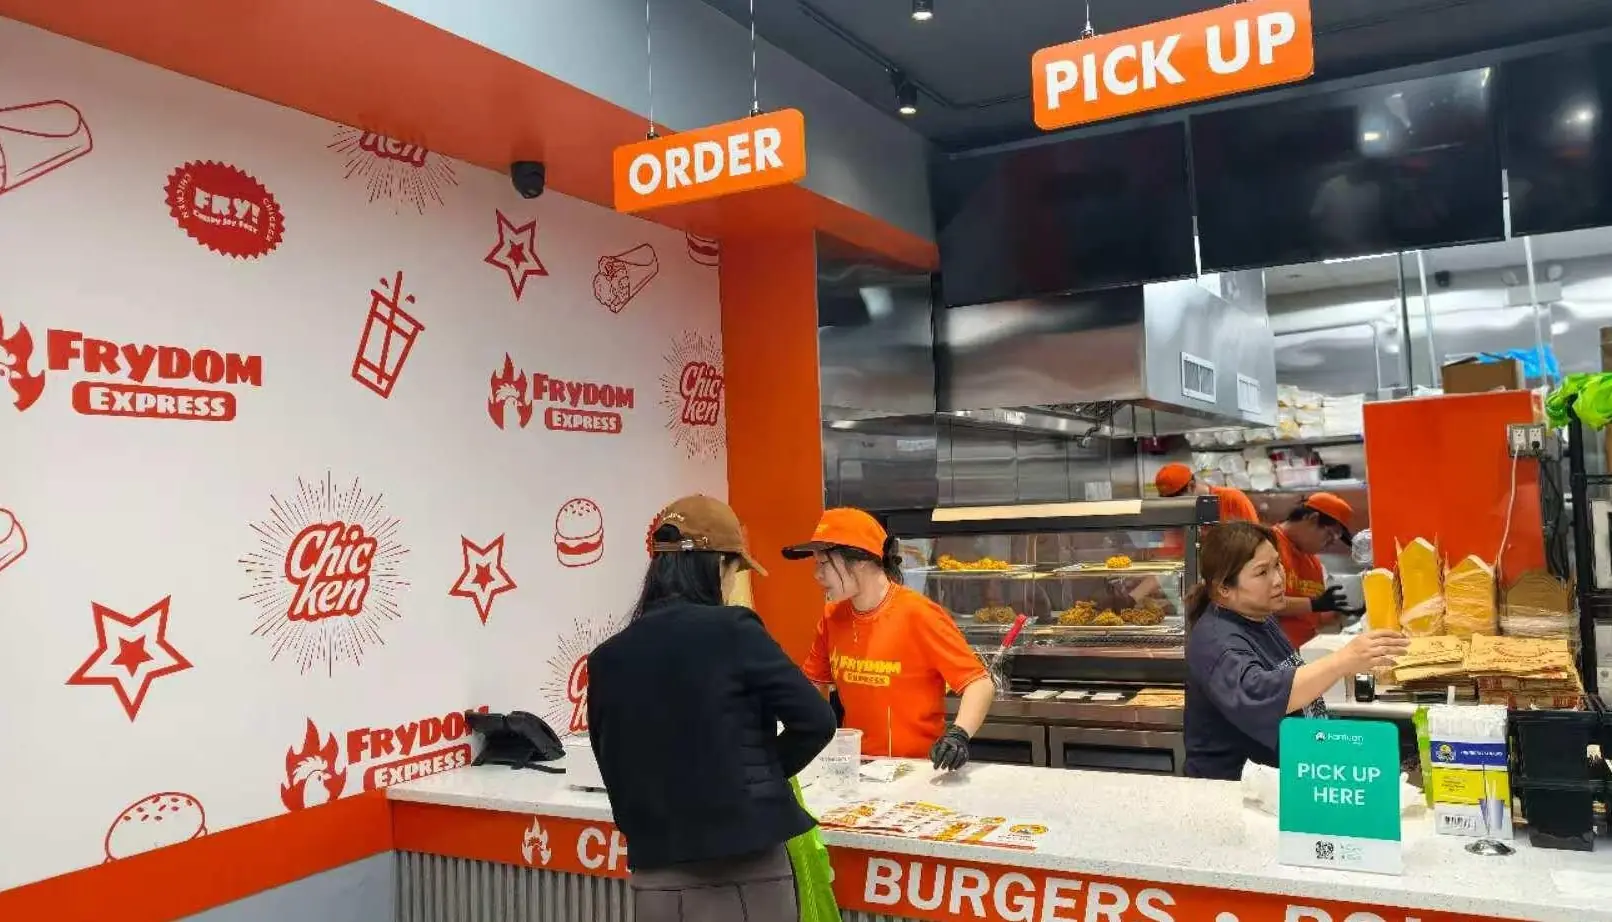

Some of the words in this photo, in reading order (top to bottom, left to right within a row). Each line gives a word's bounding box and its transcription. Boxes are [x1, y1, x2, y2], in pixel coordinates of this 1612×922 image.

[1045, 34, 1185, 111] PICK
[1206, 11, 1295, 74] UP
[627, 127, 785, 196] ORDER
[194, 186, 261, 225] FRY!
[46, 328, 262, 387] FRYDOM
[89, 387, 226, 417] EXPRESS
[533, 373, 635, 409] FRYDOM
[551, 412, 617, 432] EXPRESS
[287, 523, 376, 579] Chic
[290, 575, 369, 618] ken
[374, 749, 466, 788] EXPRESS
[1297, 762, 1347, 781] PICK
[1353, 765, 1382, 783] UP
[1313, 786, 1366, 806] HERE
[864, 857, 1177, 922] BURGERS
